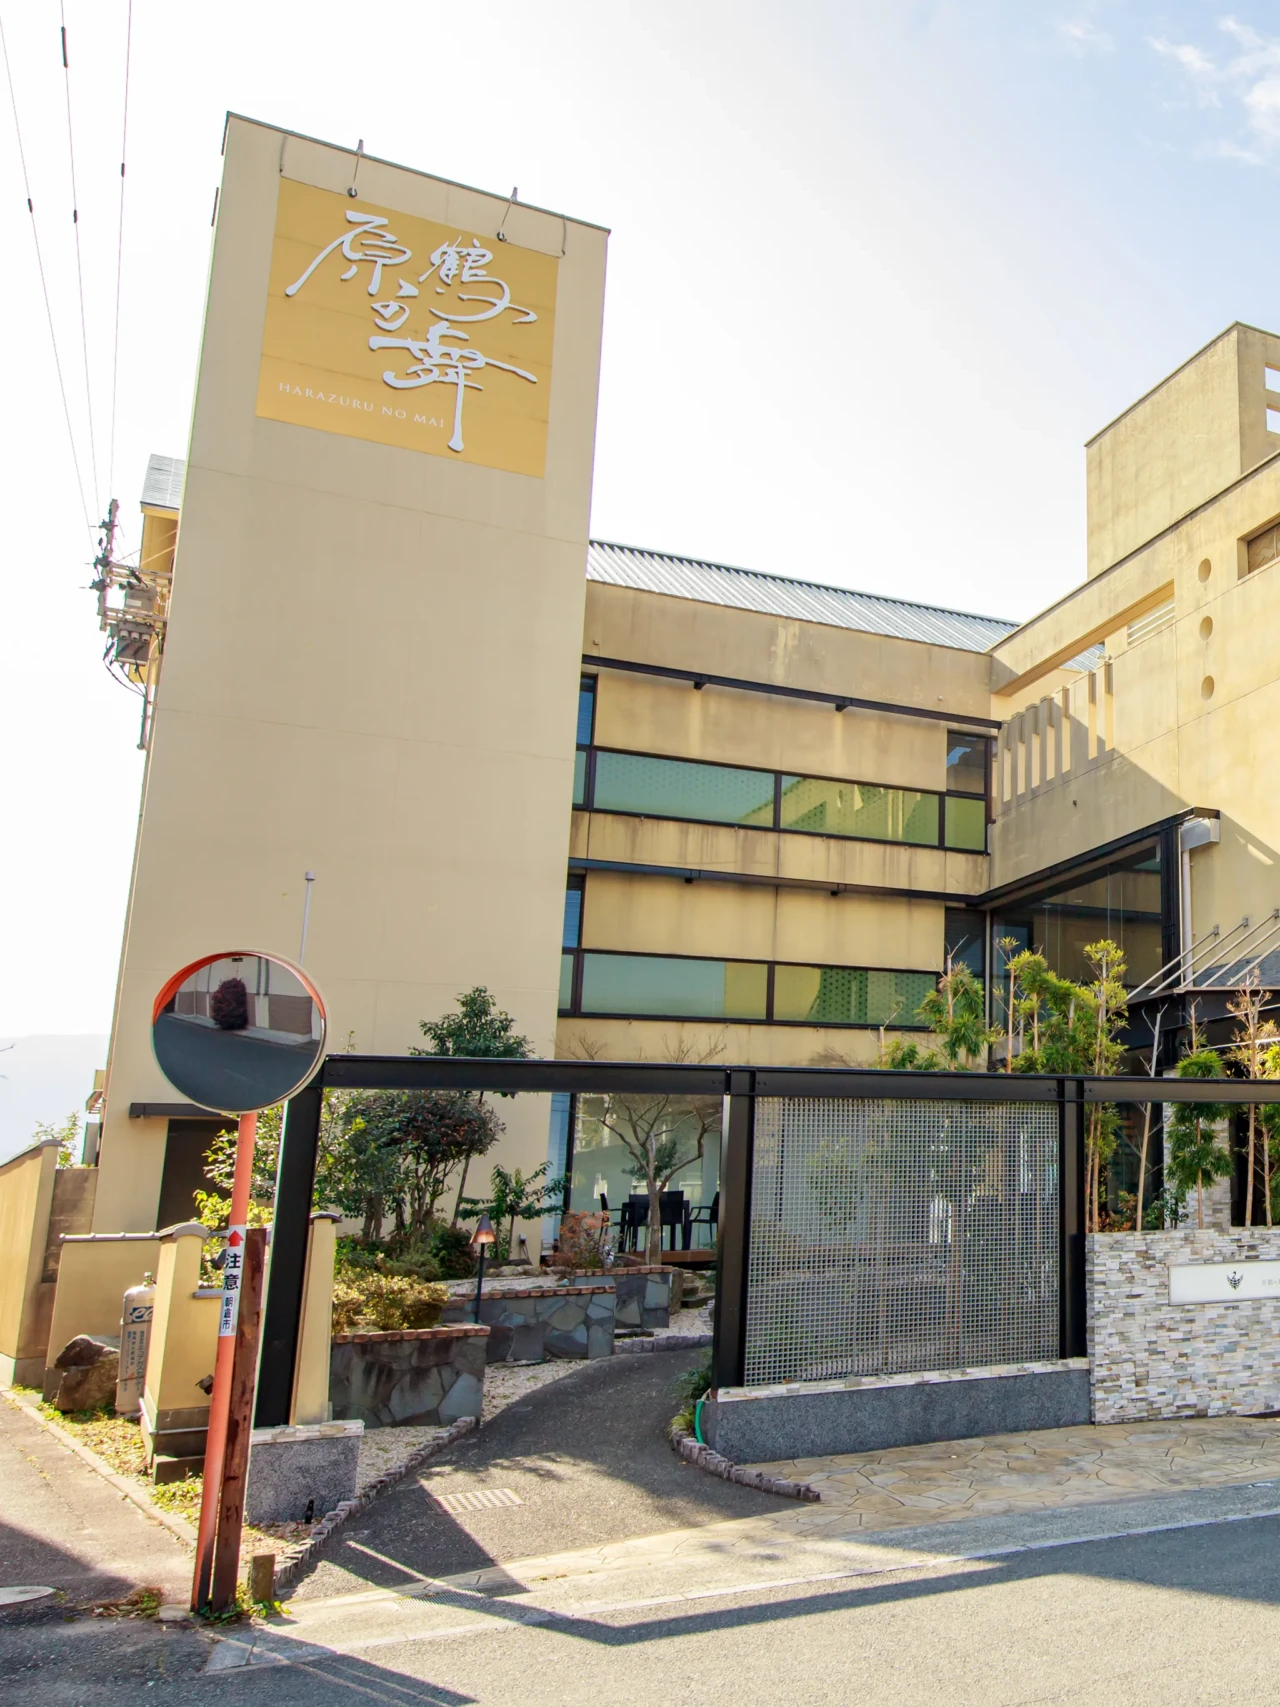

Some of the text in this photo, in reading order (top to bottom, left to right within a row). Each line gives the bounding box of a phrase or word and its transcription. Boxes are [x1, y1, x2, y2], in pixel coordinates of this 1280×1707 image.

[279, 382, 445, 428] HARAZURU NO MAI
[223, 1253, 242, 1291] 注意
